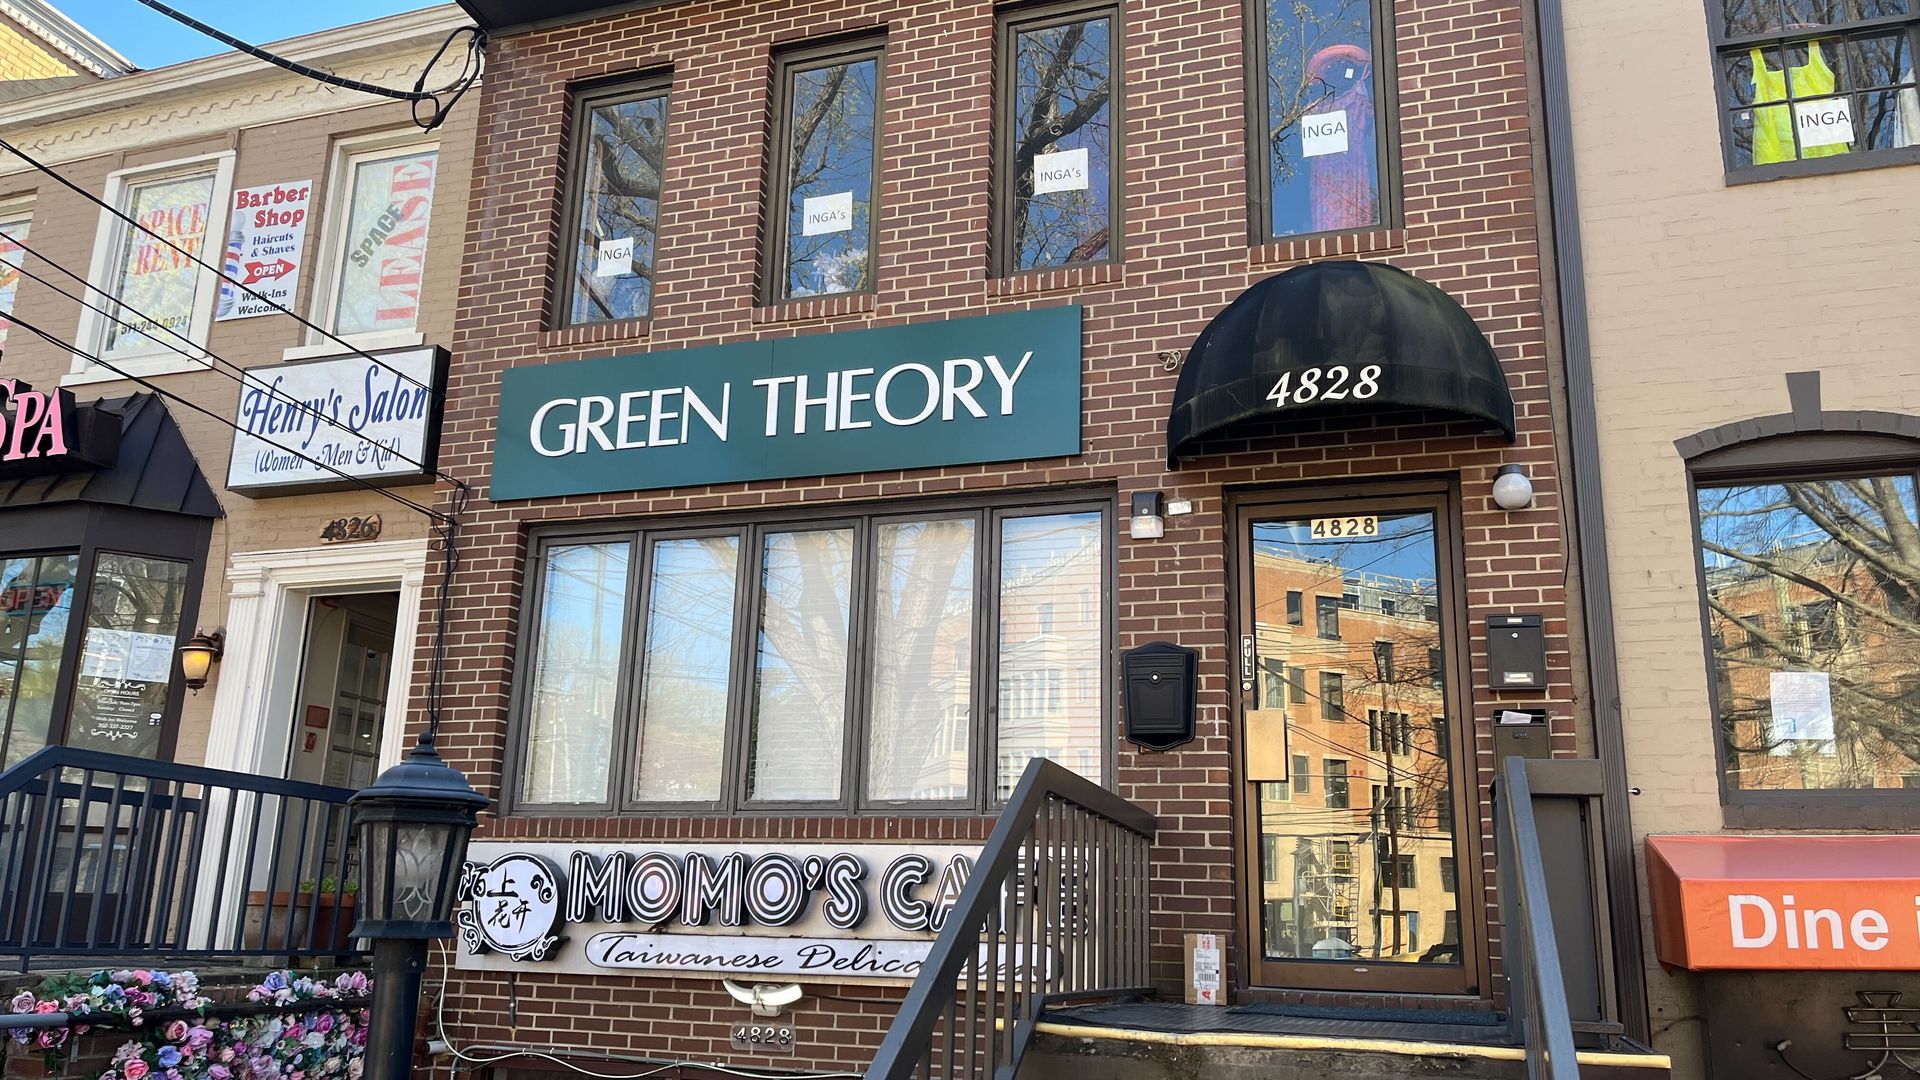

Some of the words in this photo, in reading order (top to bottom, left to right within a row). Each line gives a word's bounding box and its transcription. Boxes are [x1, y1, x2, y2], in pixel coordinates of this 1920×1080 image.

[1303, 122, 1346, 139] INGA
[1801, 110, 1849, 128] INGA
[1040, 167, 1081, 182] INGA's
[236, 186, 309, 209] Barber
[136, 203, 207, 242] SPACE
[254, 208, 305, 229] Shop
[809, 210, 846, 224] INGA's
[252, 232, 294, 246] Haircuts
[350, 203, 405, 268] SPACE
[375, 160, 433, 326] LEASE
[133, 237, 199, 276] RENT
[250, 247, 259, 258] &
[261, 244, 295, 256] Shaves
[600, 247, 632, 261] INGA
[253, 264, 284, 277] OPEN
[242, 288, 287, 302] Walk-Ins
[121, 315, 187, 336] 571-2440924
[1265, 365, 1382, 407] 4828
[243, 375, 343, 449] Henry's
[349, 364, 428, 433] Salon
[529, 382, 731, 458] GREEN
[752, 351, 1035, 437] THEORY
[315, 443, 353, 471] Men
[355, 440, 370, 465] &
[320, 516, 374, 541] 4826
[1313, 517, 1375, 537] 4828
[1243, 639, 1251, 676] PULL
[566, 850, 861, 930] MOMO'S
[1728, 895, 1889, 951] Dine
[600, 935, 784, 968] Taiwanese
[735, 1026, 791, 1045] 4828
